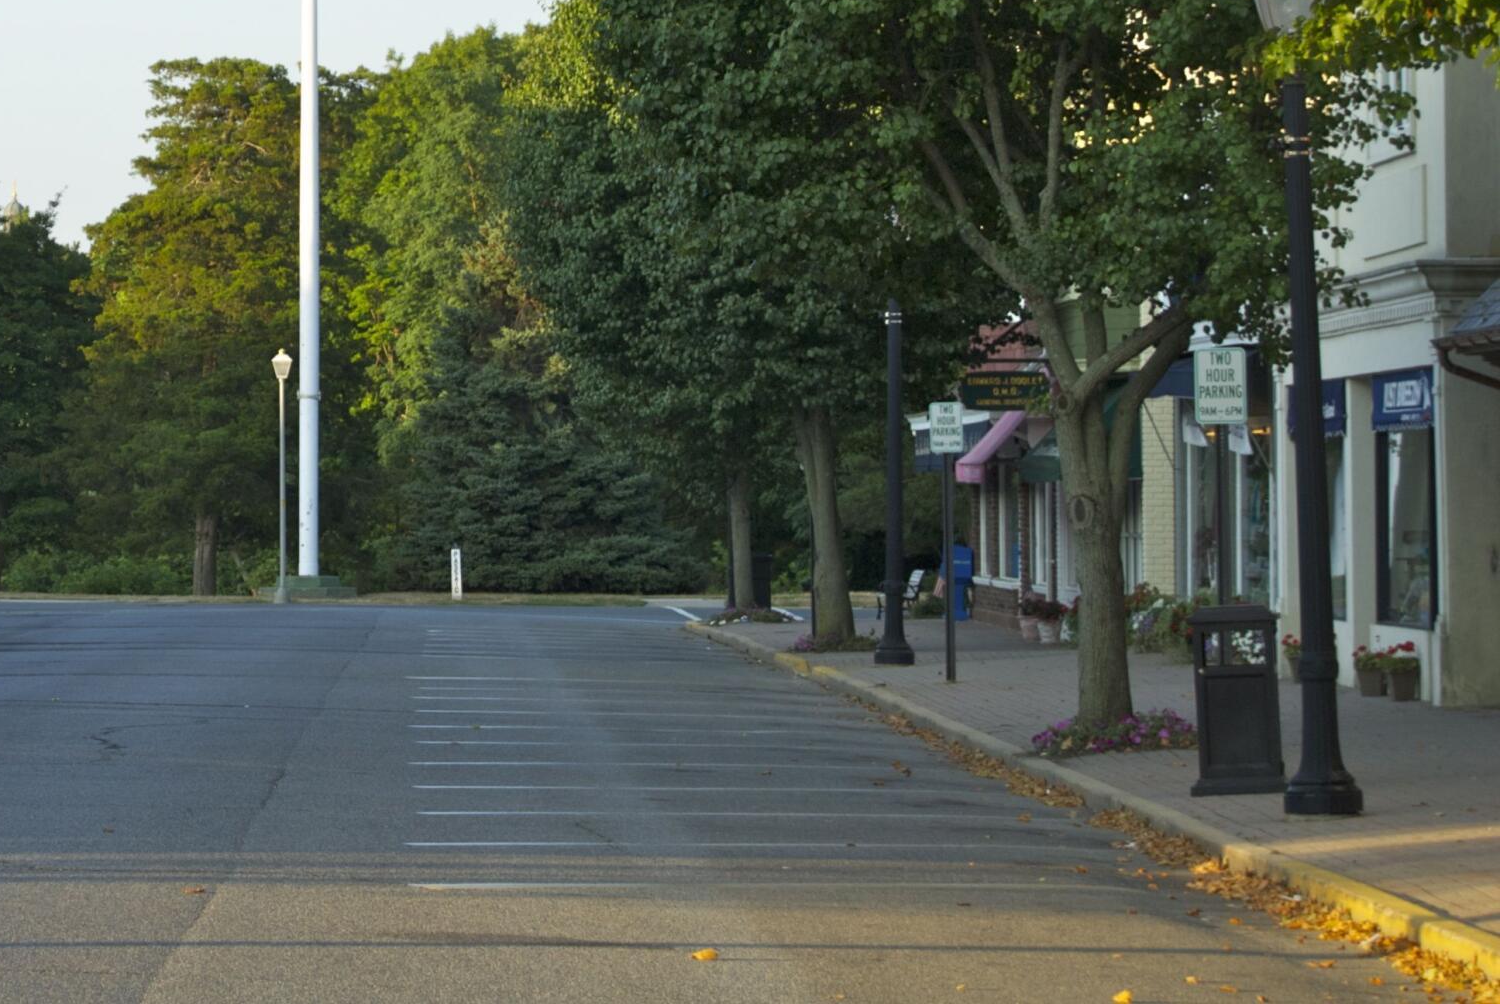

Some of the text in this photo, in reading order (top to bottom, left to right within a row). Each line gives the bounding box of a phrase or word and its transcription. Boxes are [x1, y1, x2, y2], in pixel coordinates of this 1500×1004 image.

[1210, 352, 1232, 365] TWO
[1206, 369, 1235, 382] HOUR
[1199, 385, 1243, 398] PARKING
[939, 404, 953, 414] TWO
[936, 416, 956, 425] HOUR
[932, 427, 961, 436] PARKING
